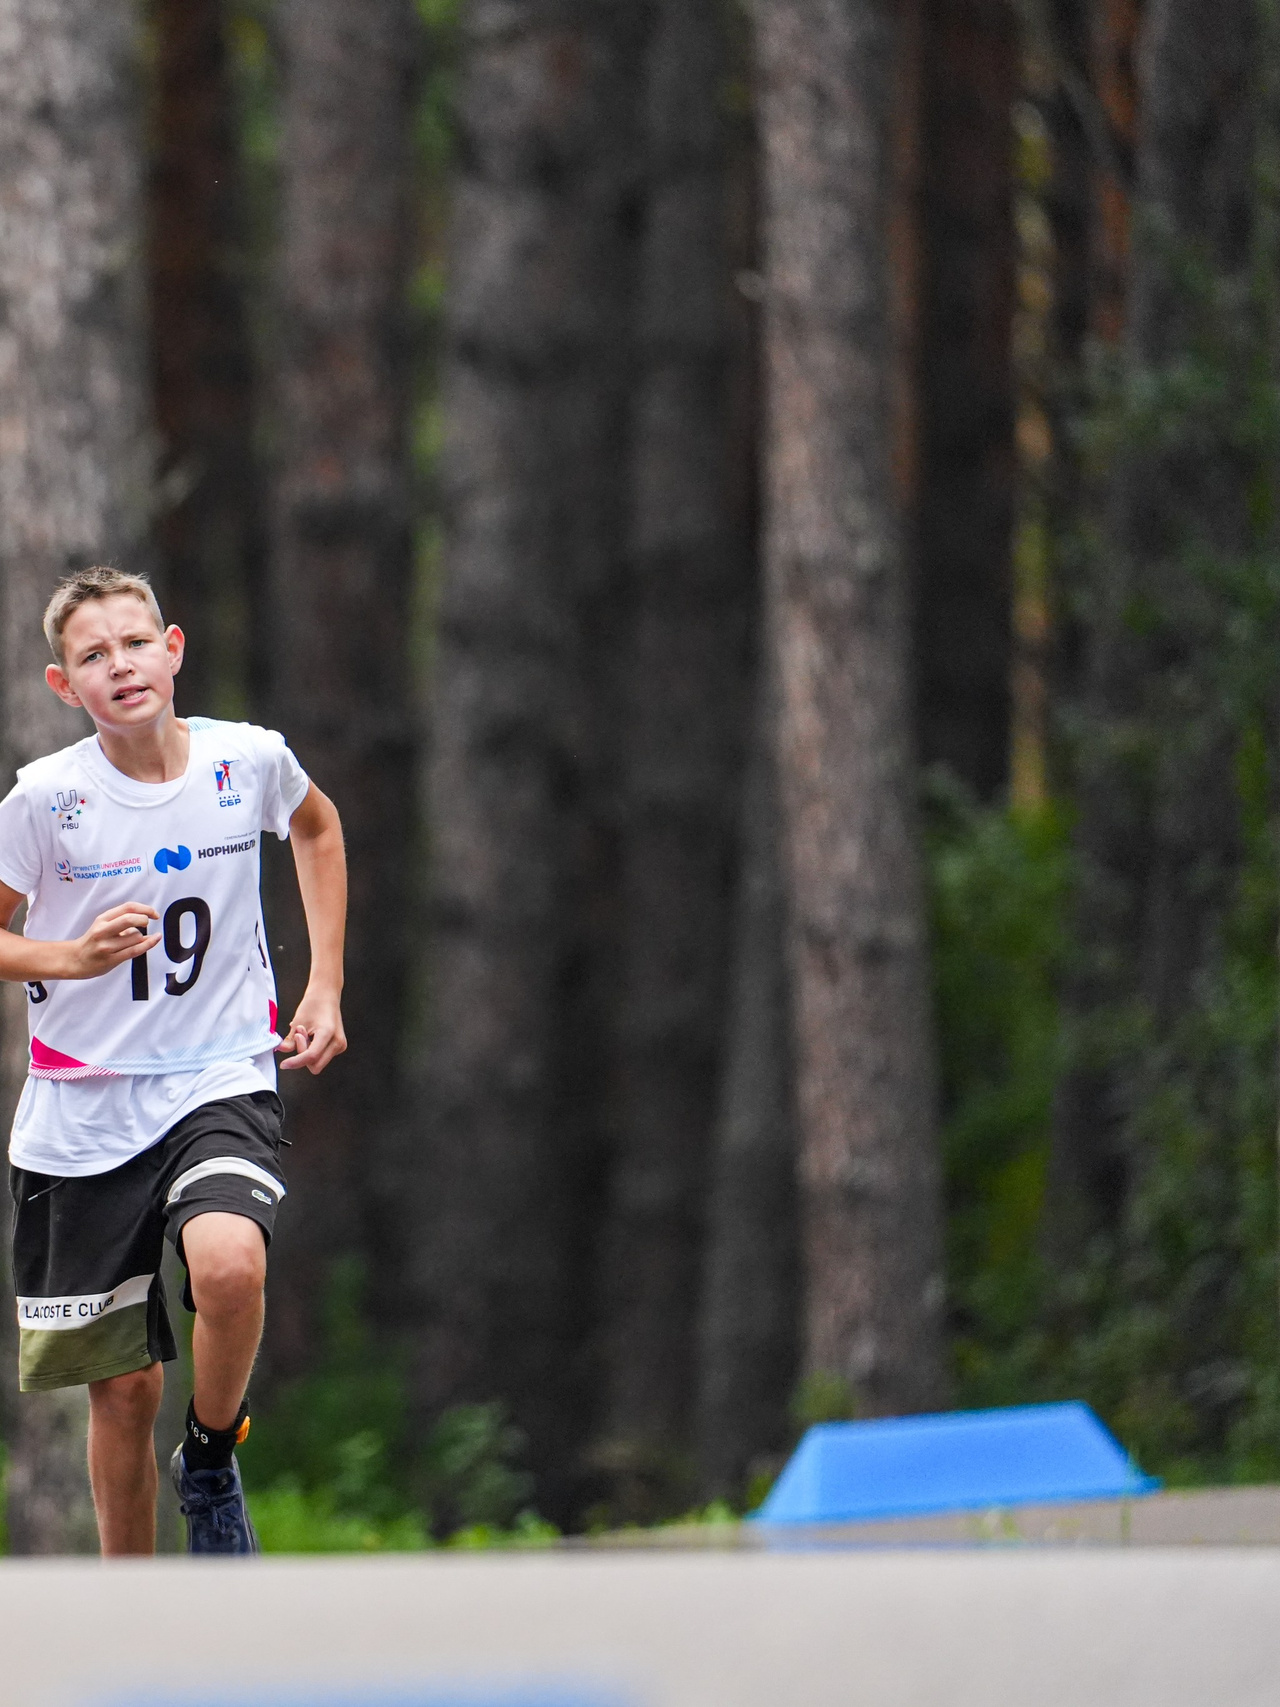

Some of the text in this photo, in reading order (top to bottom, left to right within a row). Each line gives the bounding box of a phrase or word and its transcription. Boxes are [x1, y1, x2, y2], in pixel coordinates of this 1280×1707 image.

[219, 798, 241, 808] СБР
[61, 822, 79, 830] FISU
[197, 838, 256, 860] НОРНИКЕЛЬ
[73, 868, 123, 880] KRASNOARSK
[124, 865, 142, 875] 2019
[100, 857, 141, 870] UNIVERSIADE
[131, 896, 212, 1002] 19
[25, 1295, 115, 1319] LACOSTE CLUB
[190, 1420, 209, 1444] 169
